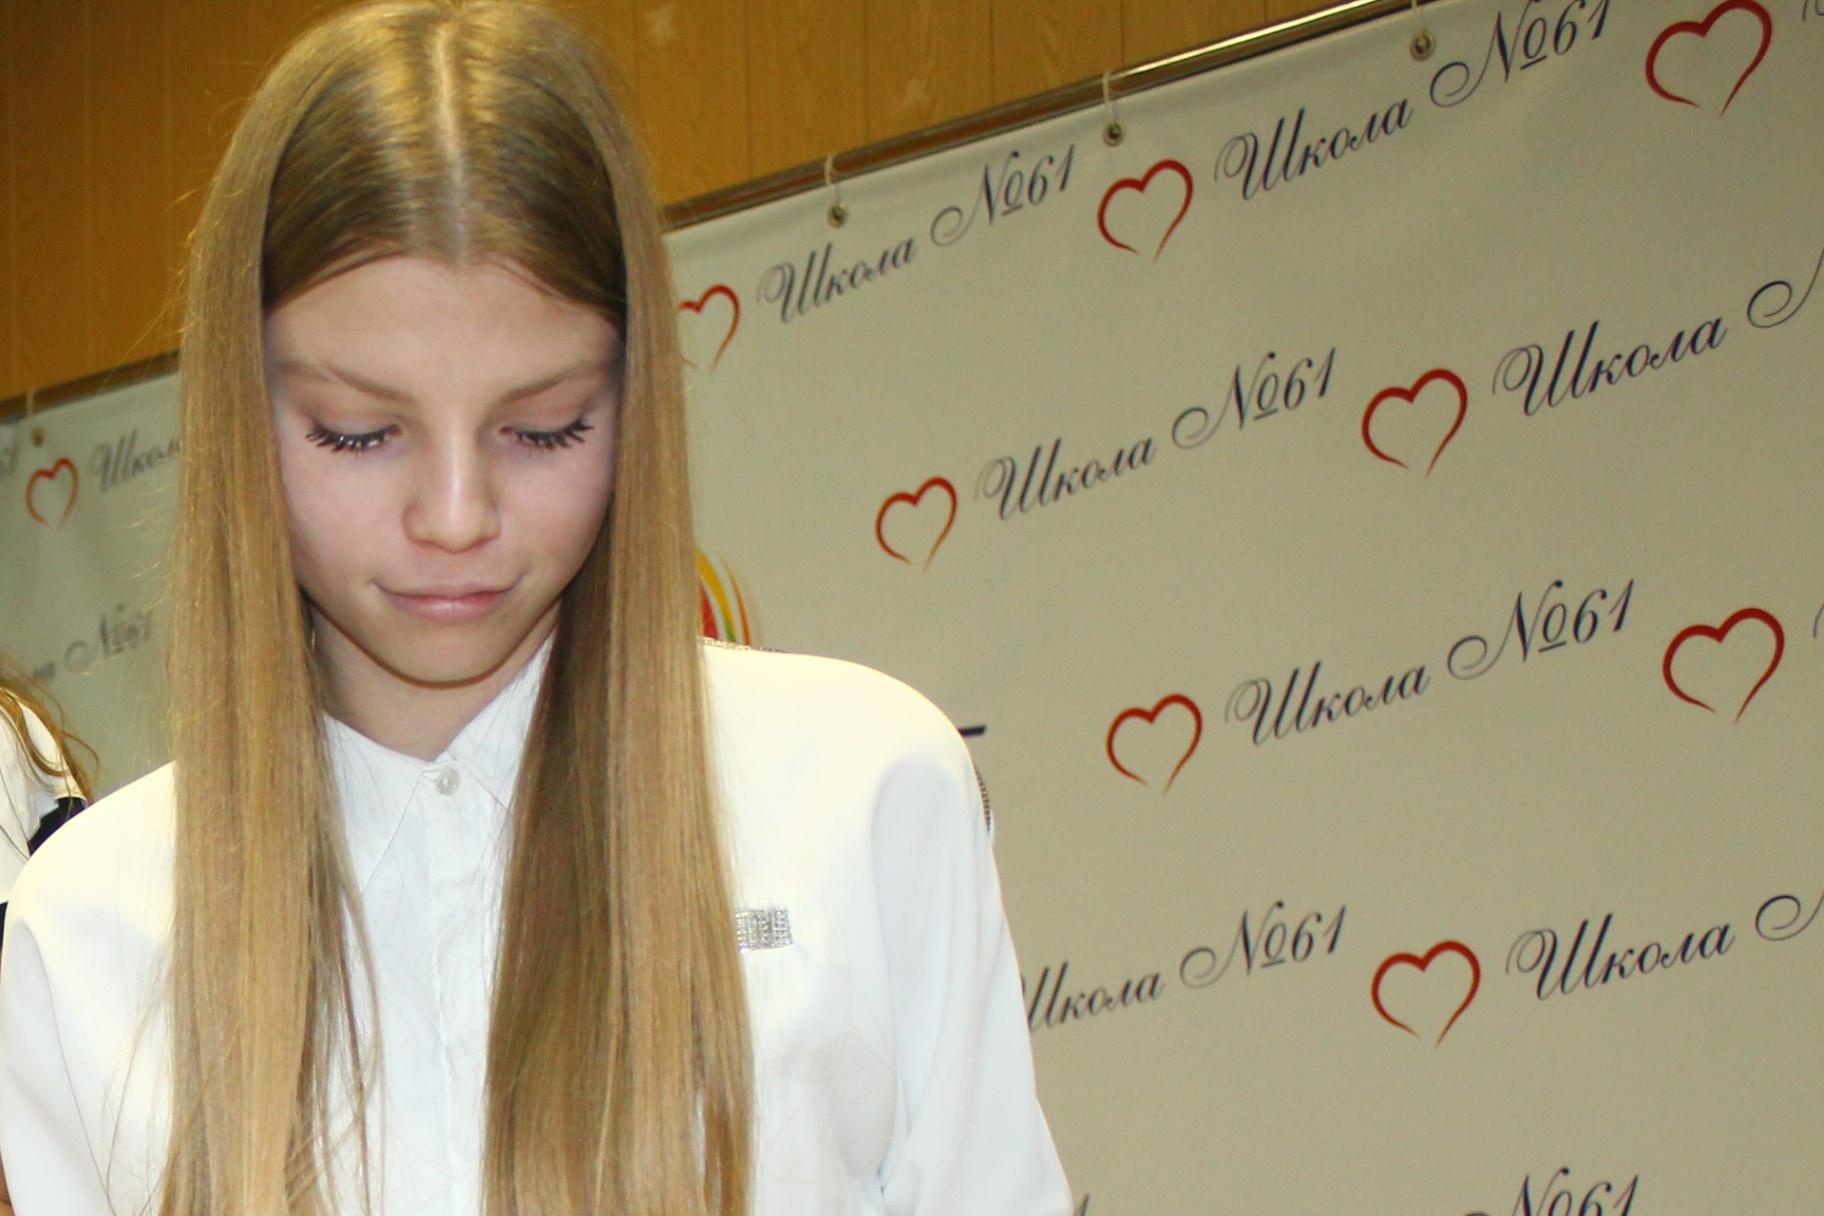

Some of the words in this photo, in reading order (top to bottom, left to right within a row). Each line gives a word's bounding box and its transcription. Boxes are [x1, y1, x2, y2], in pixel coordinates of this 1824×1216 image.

[1214, 98, 1413, 201] Школа
[1429, 0, 1609, 108] №61
[756, 242, 918, 325] Школа
[930, 144, 1075, 248] №61
[975, 437, 1157, 521] Школа
[1171, 347, 1336, 451] №61
[1492, 317, 1728, 417] Школа
[1224, 661, 1430, 747] Школа
[1447, 578, 1635, 681] №61
[1179, 900, 1347, 990] №61
[1504, 911, 1736, 1002] Школа
